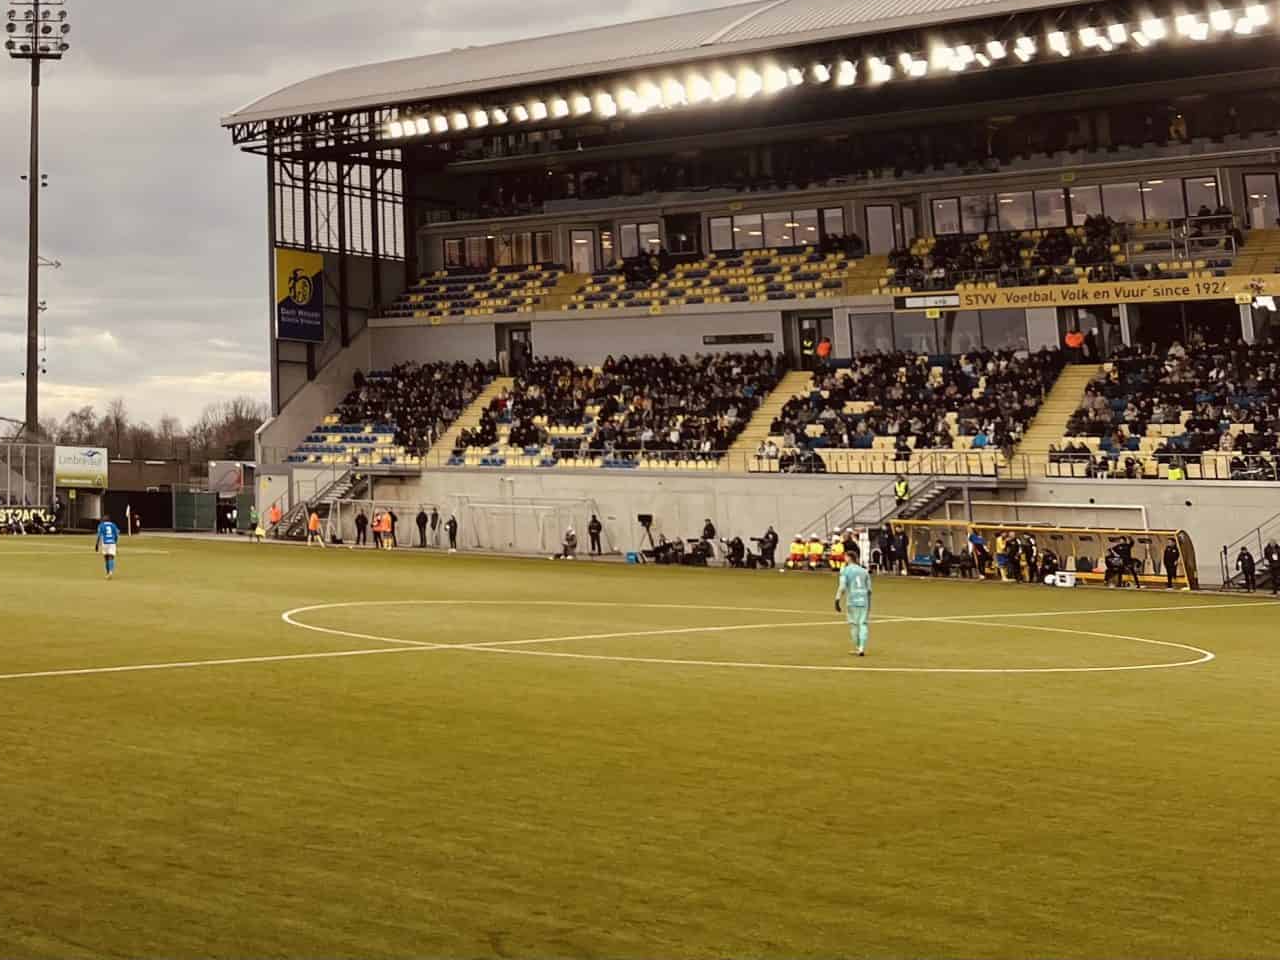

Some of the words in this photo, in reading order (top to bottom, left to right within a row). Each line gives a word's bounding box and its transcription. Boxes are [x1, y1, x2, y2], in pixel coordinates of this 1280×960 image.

[965, 294, 997, 305] STVV
[1061, 289, 1089, 300] Volk
[1094, 290, 1110, 300] en
[1153, 285, 1190, 297] since
